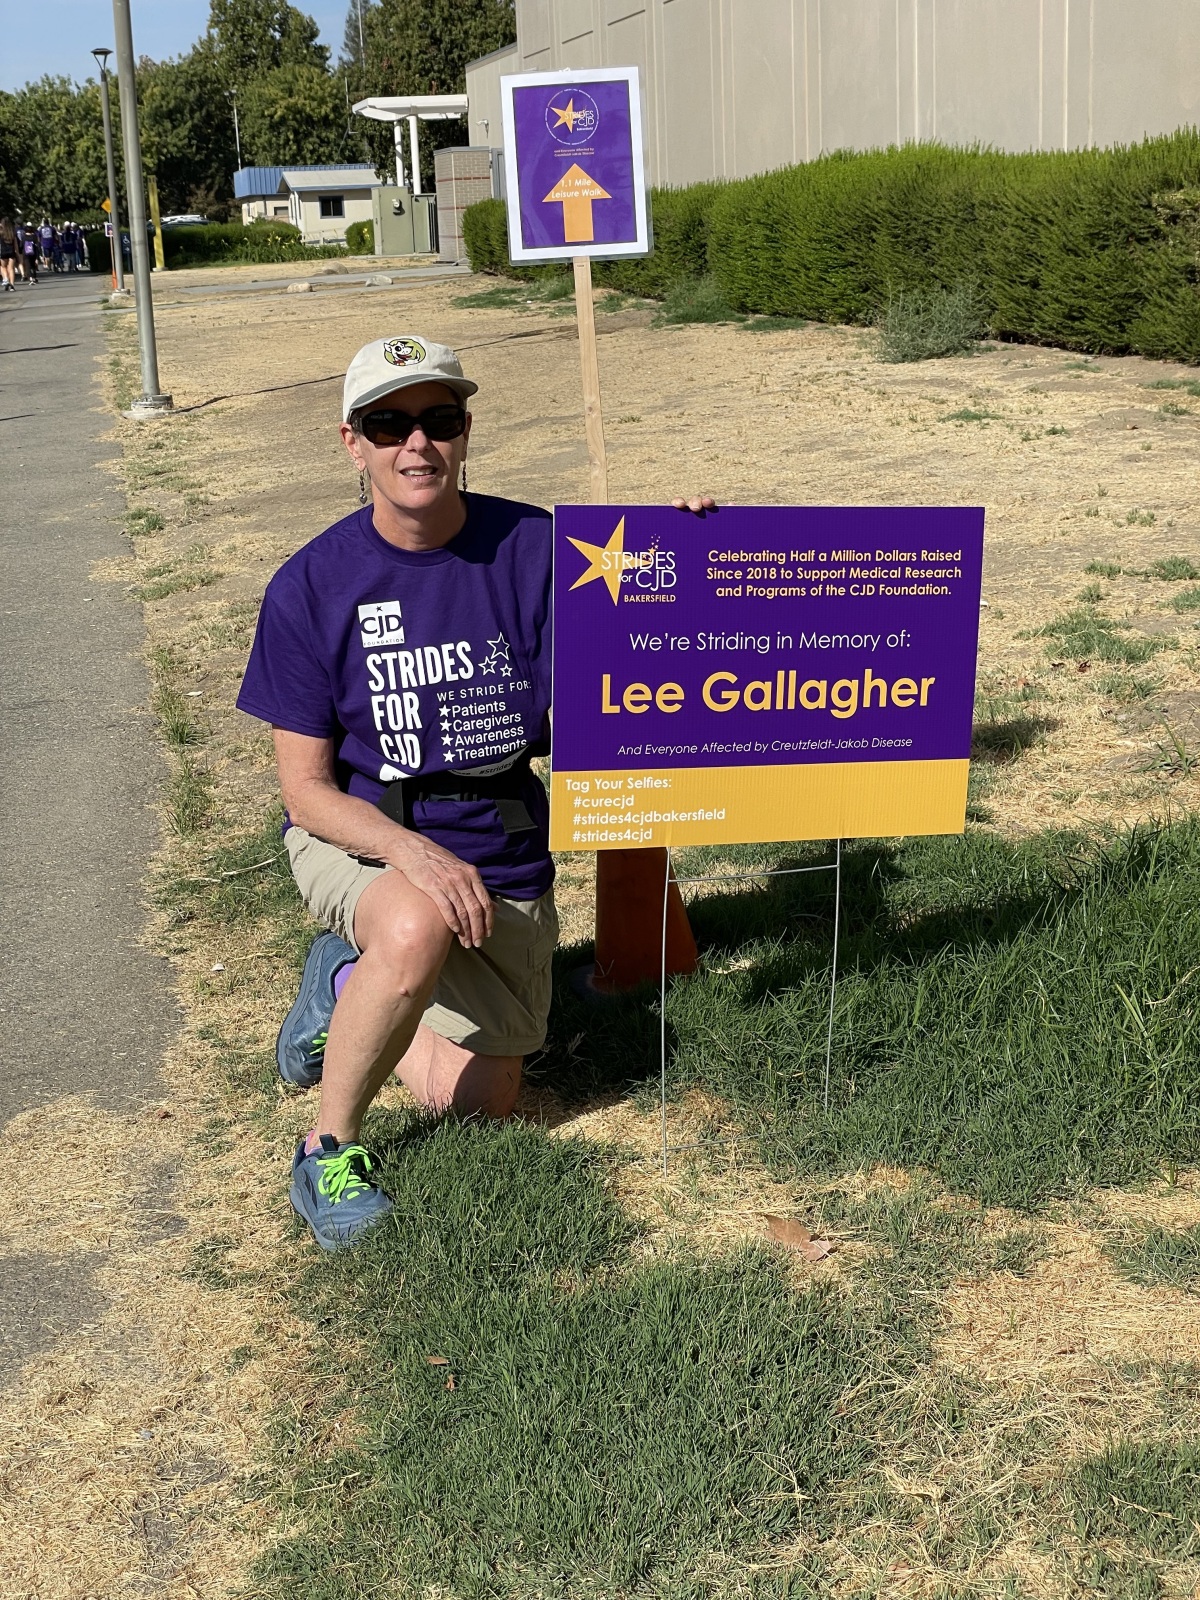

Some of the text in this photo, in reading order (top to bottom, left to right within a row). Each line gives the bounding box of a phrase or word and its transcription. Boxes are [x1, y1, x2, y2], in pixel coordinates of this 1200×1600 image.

[578, 117, 594, 127] CJD
[561, 179, 591, 188] 1.1 Mile
[551, 188, 602, 199] Leisure Walk
[601, 551, 676, 570] STRIDES
[708, 549, 962, 565] Celebrating Half a Million Dollars Raised
[618, 569, 677, 591] for CJD
[706, 566, 962, 582] Since 2018 to Support Medical Research
[624, 594, 676, 603] BAKERSFIELD
[716, 583, 952, 600] and Programs of the CJD Foundation.
[360, 614, 404, 639] CJD
[696, 631, 770, 654] Striding
[776, 631, 793, 650] in
[799, 631, 881, 652] Memory
[886, 629, 911, 648] of:
[366, 641, 474, 692] STRIDES
[437, 680, 532, 702] WE STRIDE FOR:
[601, 668, 936, 719] Lee Gallagher
[371, 691, 423, 731] FOR
[452, 701, 506, 718] Patients
[453, 713, 521, 732] Caregivers
[455, 726, 524, 747] Awareness
[380, 733, 421, 769] CJD
[456, 739, 527, 761] Treatments
[617, 737, 913, 757] And Everyone Affected by Creutzfeldt-Jakob Disease
[566, 776, 673, 793] Tag Your Selfies:
[573, 794, 635, 809] #curecjd
[573, 808, 726, 826] #strides4cjdbakersfield
[572, 828, 653, 843] #strides4cjd
